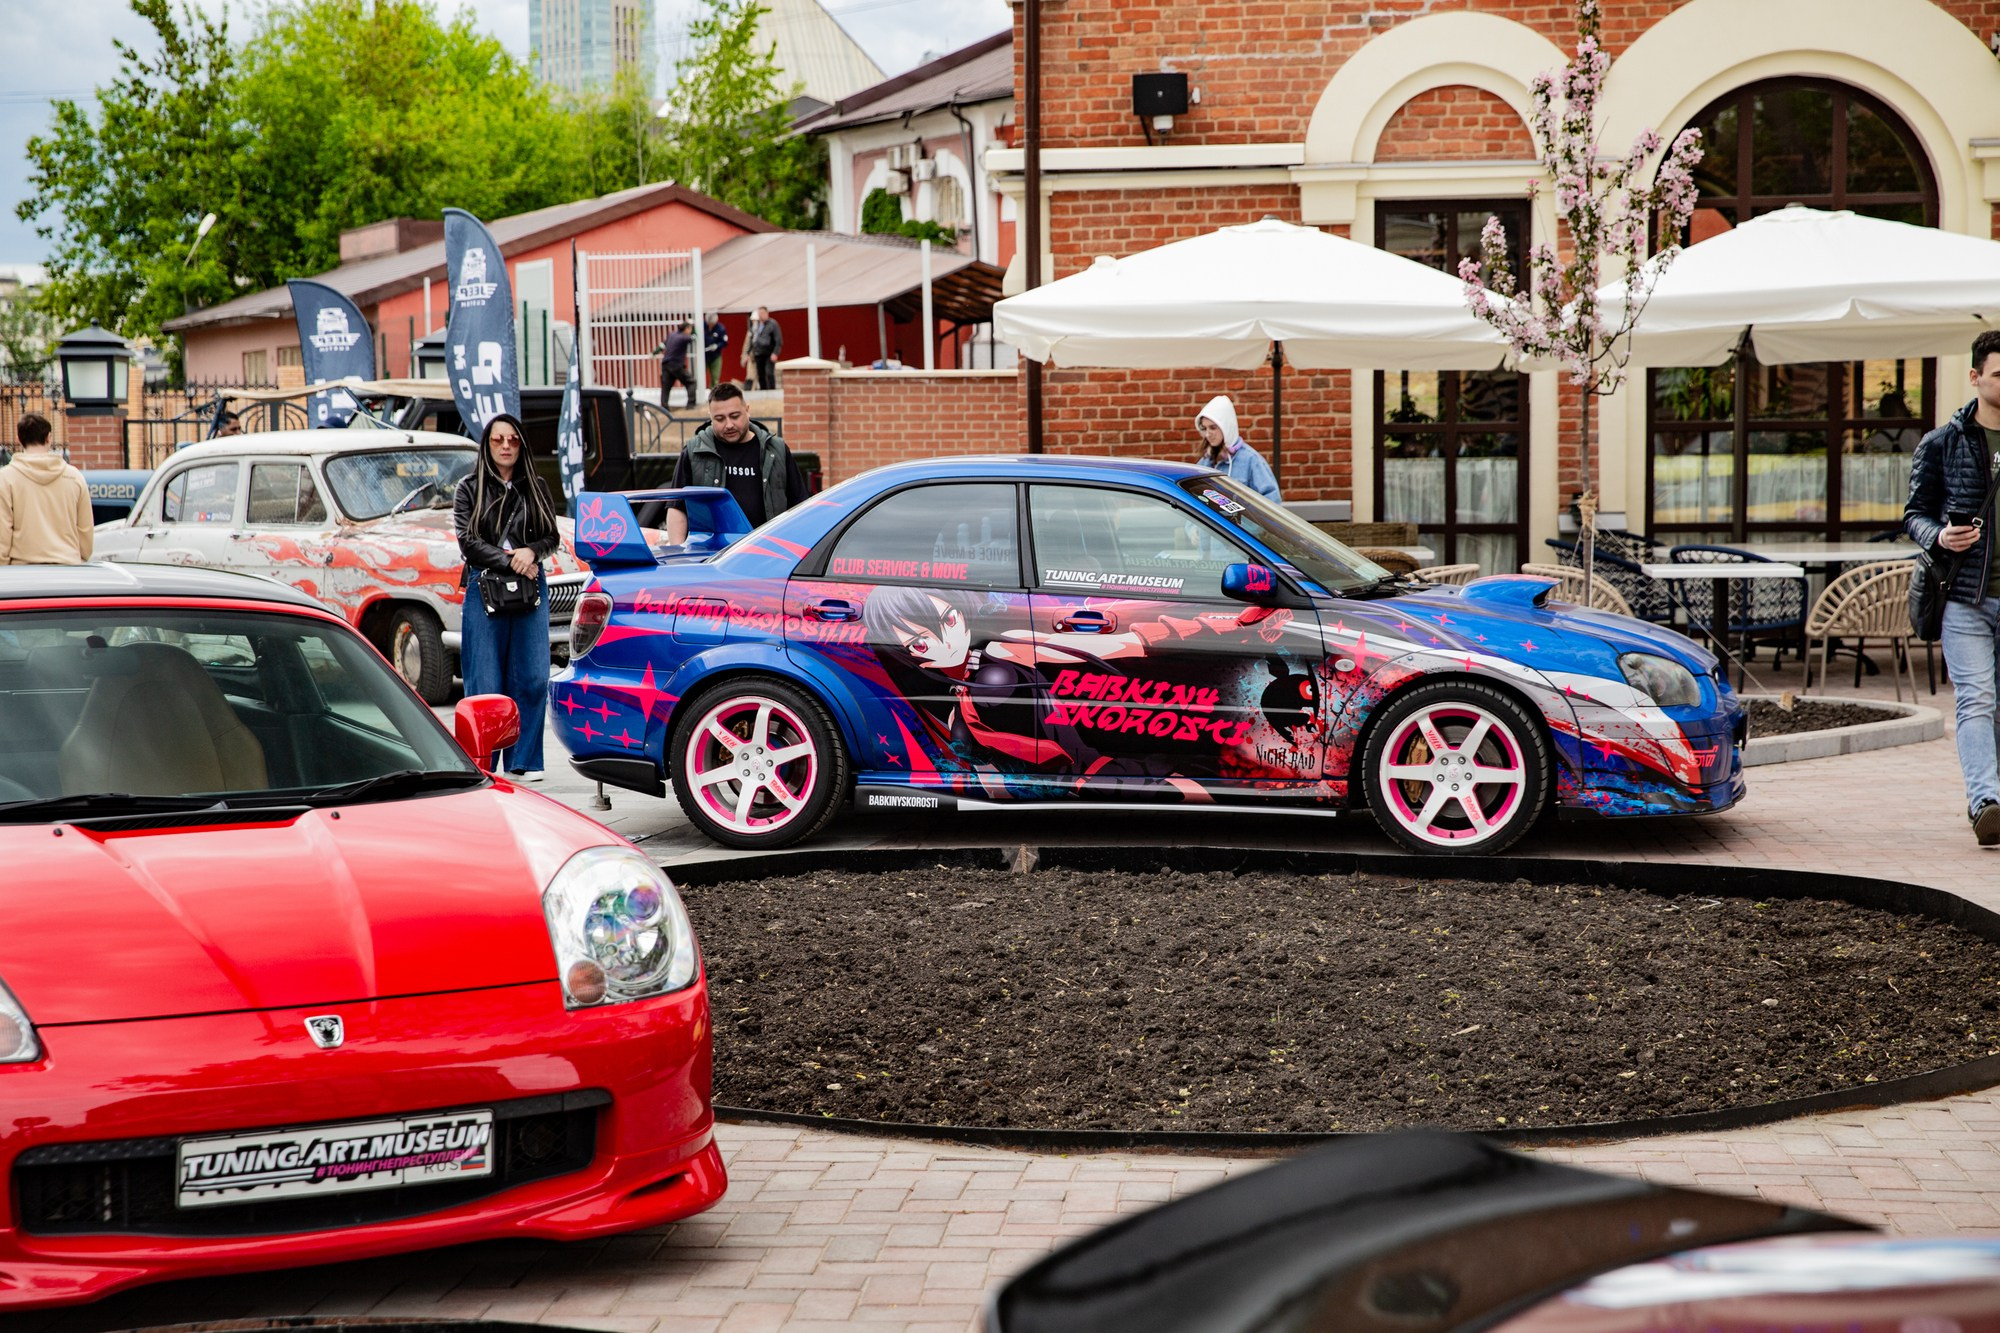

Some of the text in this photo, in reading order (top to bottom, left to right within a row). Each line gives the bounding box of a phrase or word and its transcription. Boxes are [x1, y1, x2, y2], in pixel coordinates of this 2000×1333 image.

[833, 558, 968, 580] CLUB SERVICE & MOVE
[1045, 569, 1184, 589] TUNING.ART.MUSEUM
[869, 795, 938, 808] BABKINYSKOROSTI
[184, 1122, 491, 1180] TUNING.ART.MUSEUM
[424, 1159, 459, 1174] RUS
